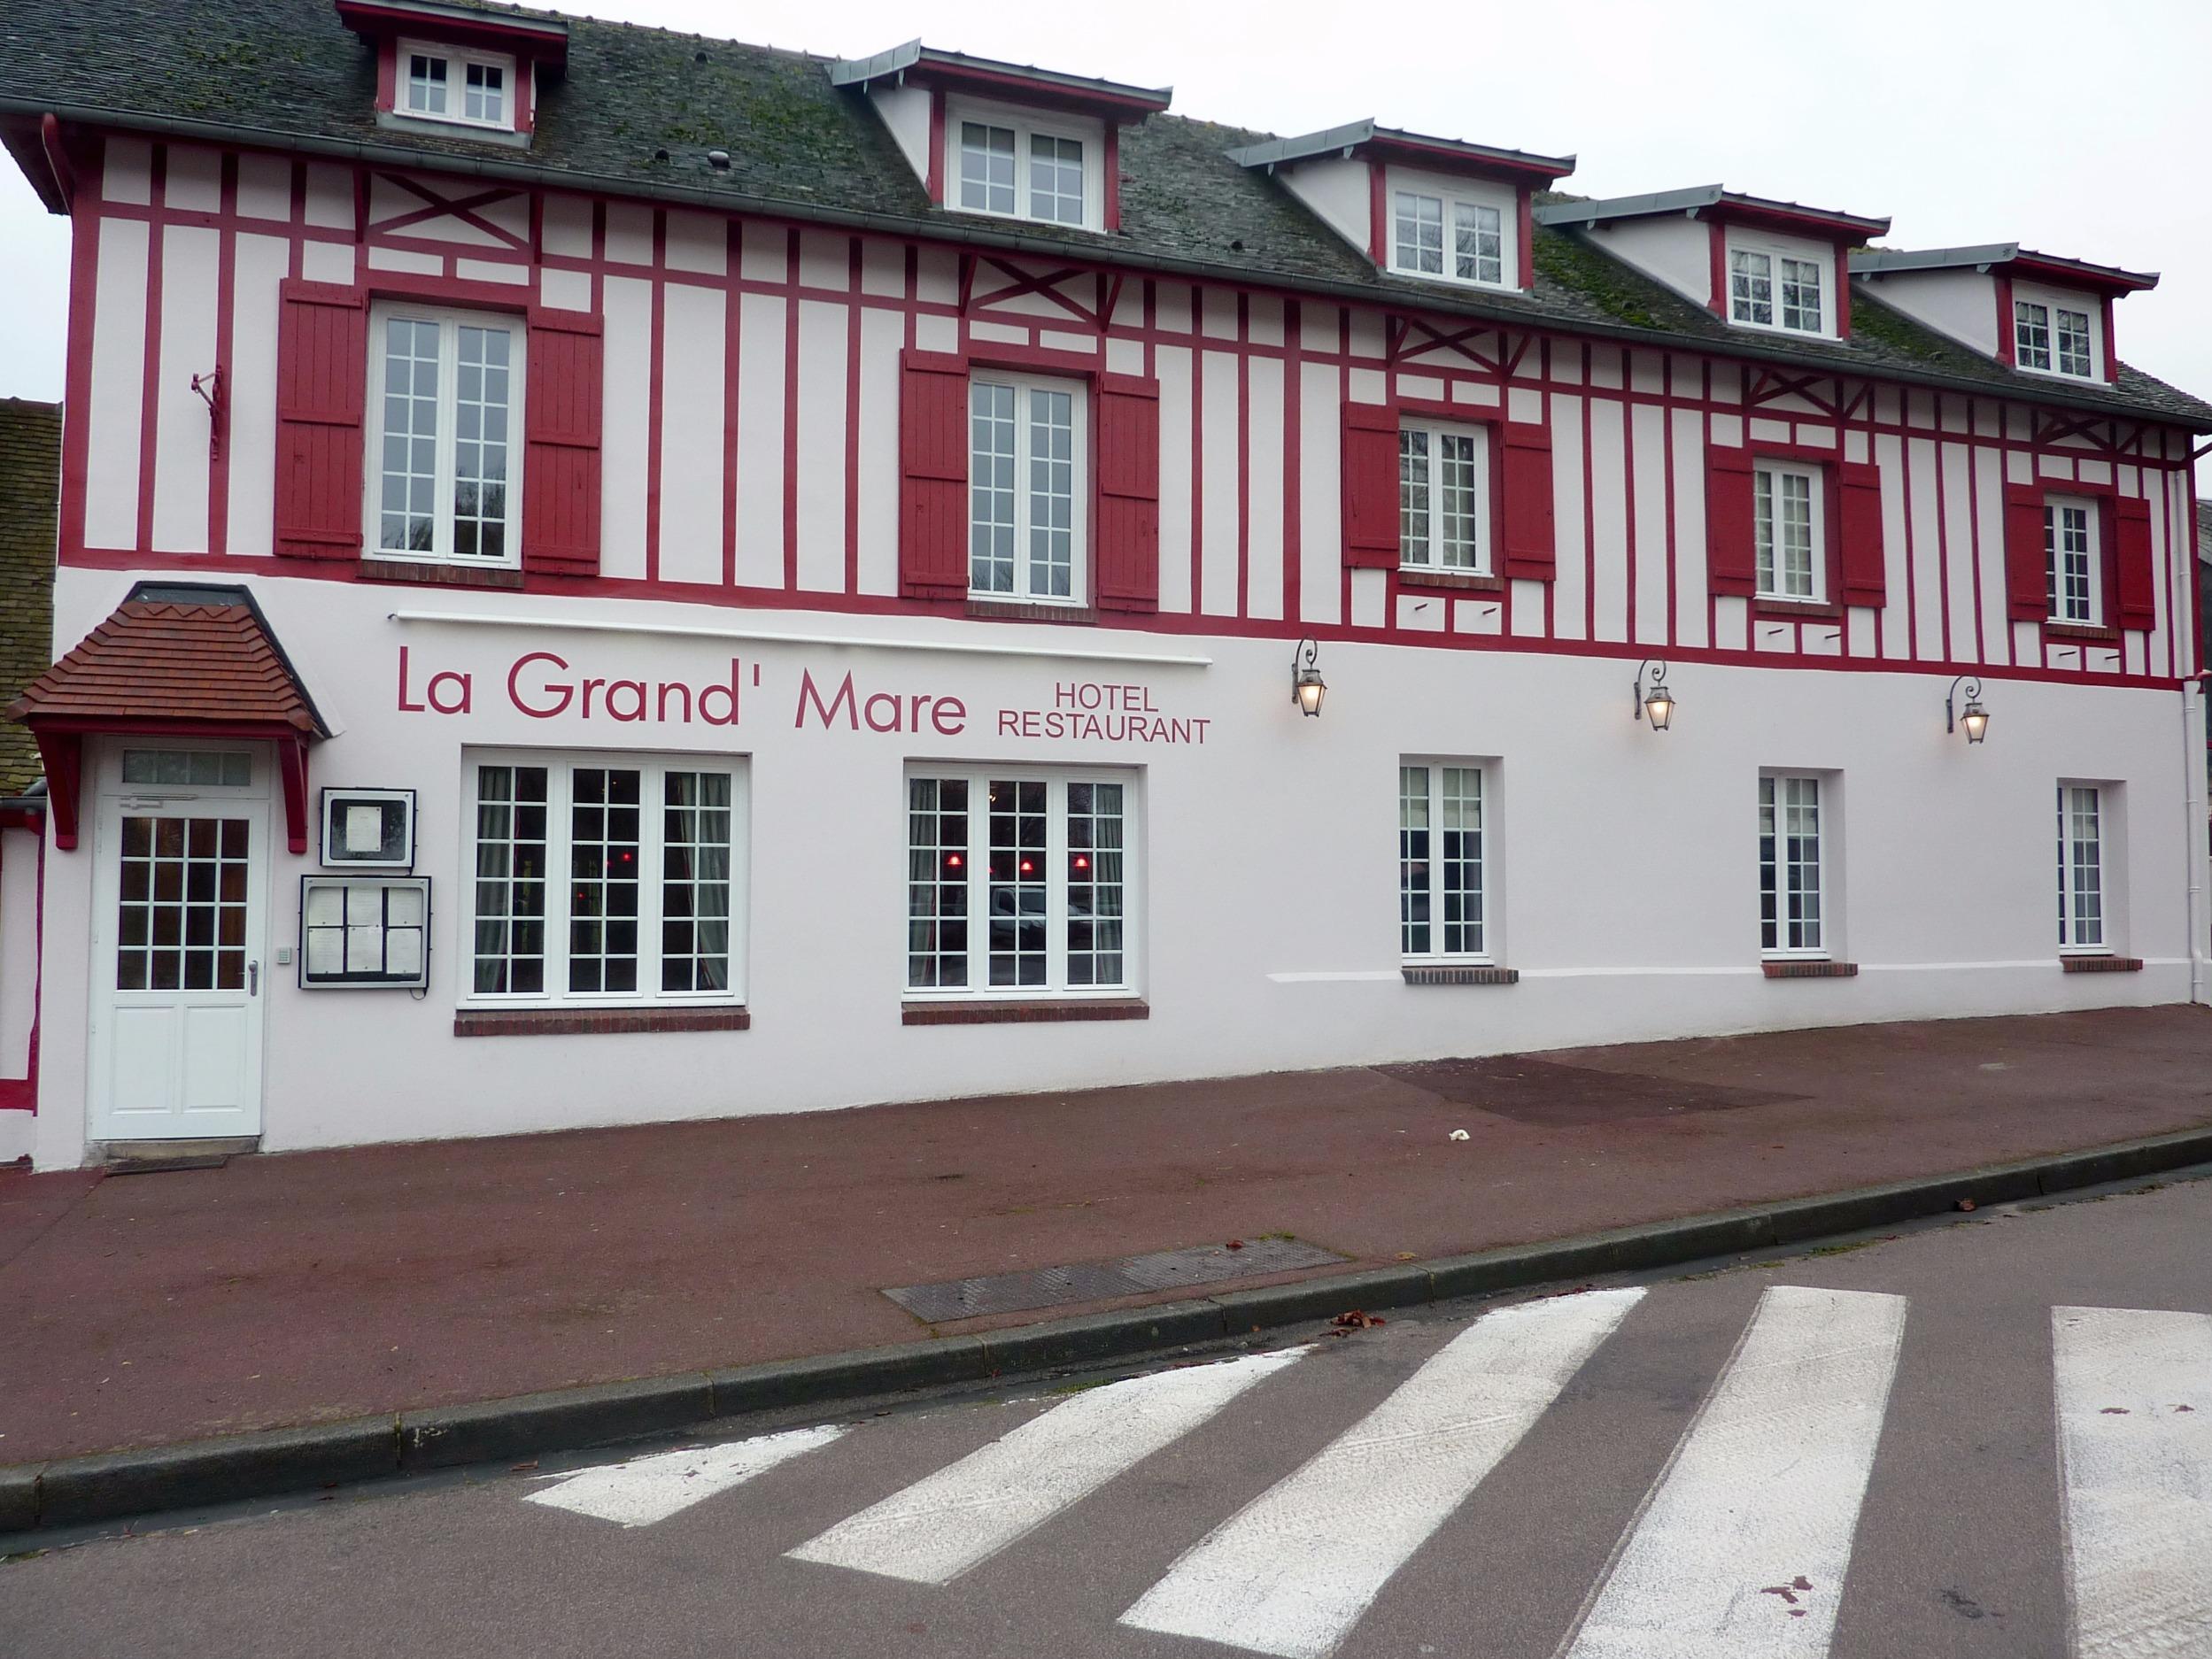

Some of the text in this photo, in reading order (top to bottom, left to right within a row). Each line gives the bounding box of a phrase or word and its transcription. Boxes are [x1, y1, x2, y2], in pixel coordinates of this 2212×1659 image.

[398, 646, 472, 715] La
[794, 667, 968, 736] Mare
[1054, 682, 1159, 713] HOTEL
[997, 710, 1211, 745] RESTAURANT
